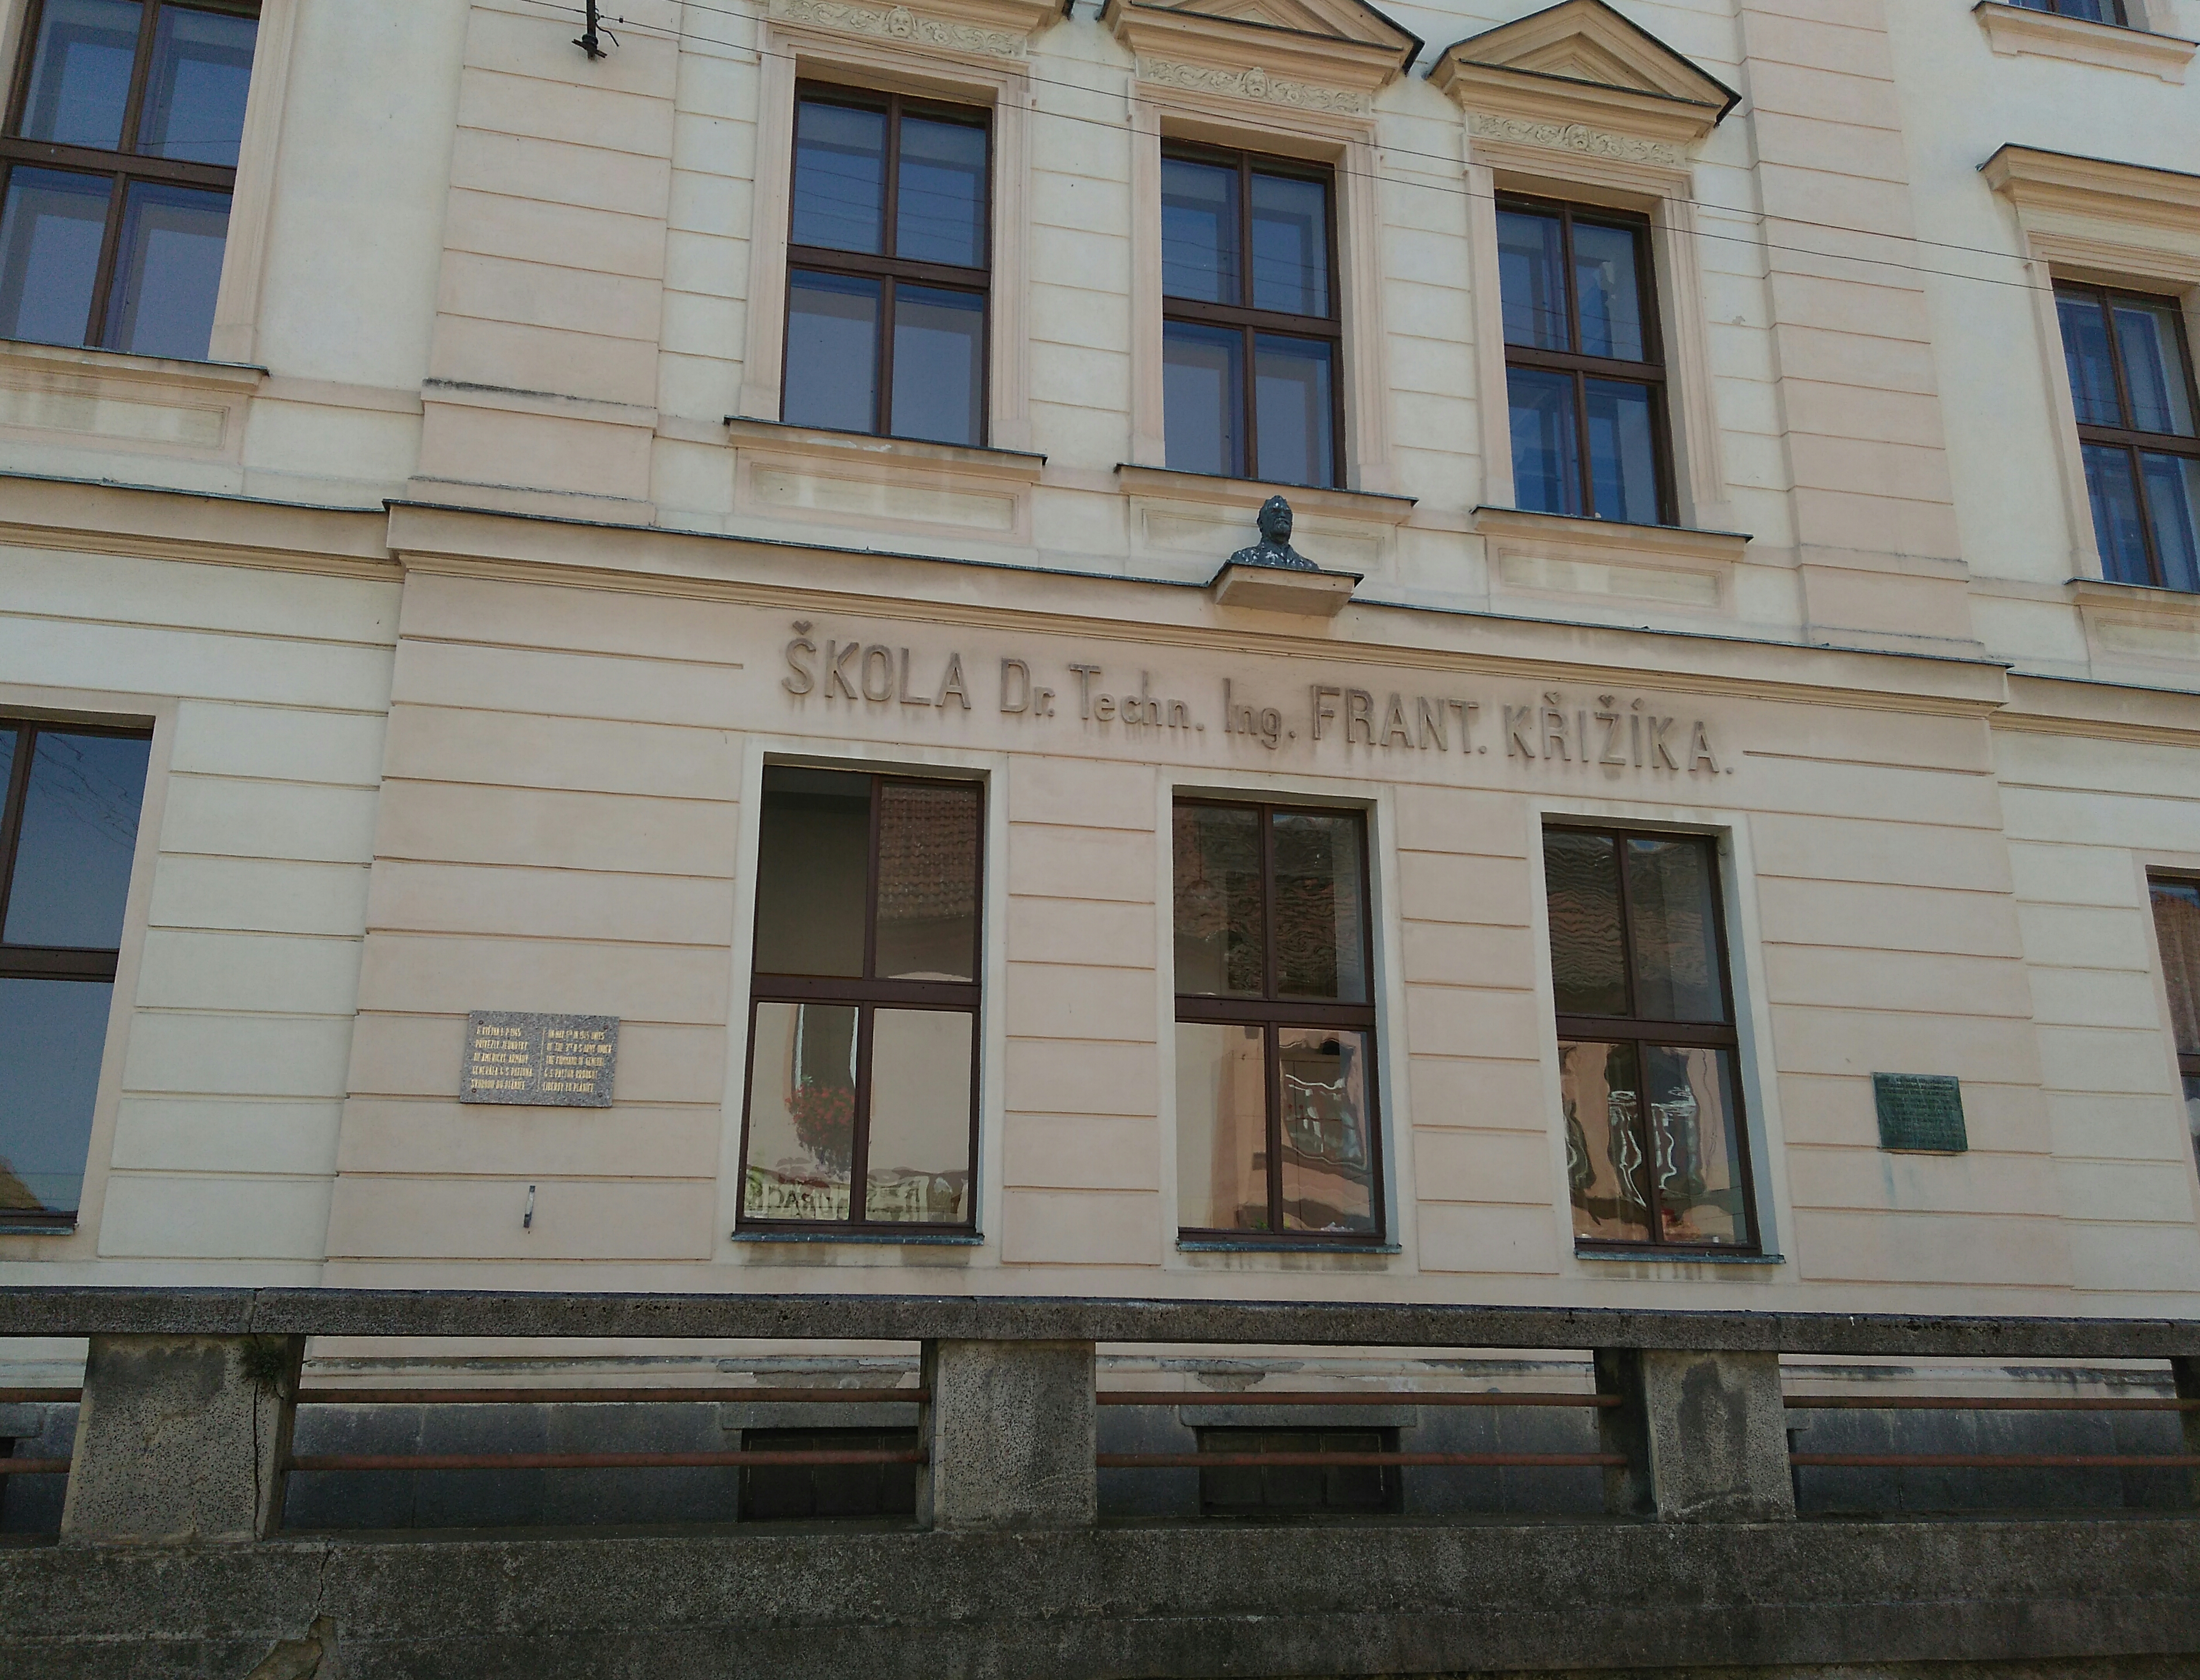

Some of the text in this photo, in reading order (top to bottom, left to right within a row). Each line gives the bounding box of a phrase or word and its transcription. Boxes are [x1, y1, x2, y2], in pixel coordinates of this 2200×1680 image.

[782, 620, 1734, 774] ŠKOLA Dr. Techn. Ing. FRANT. KŘIŽÍKA.
